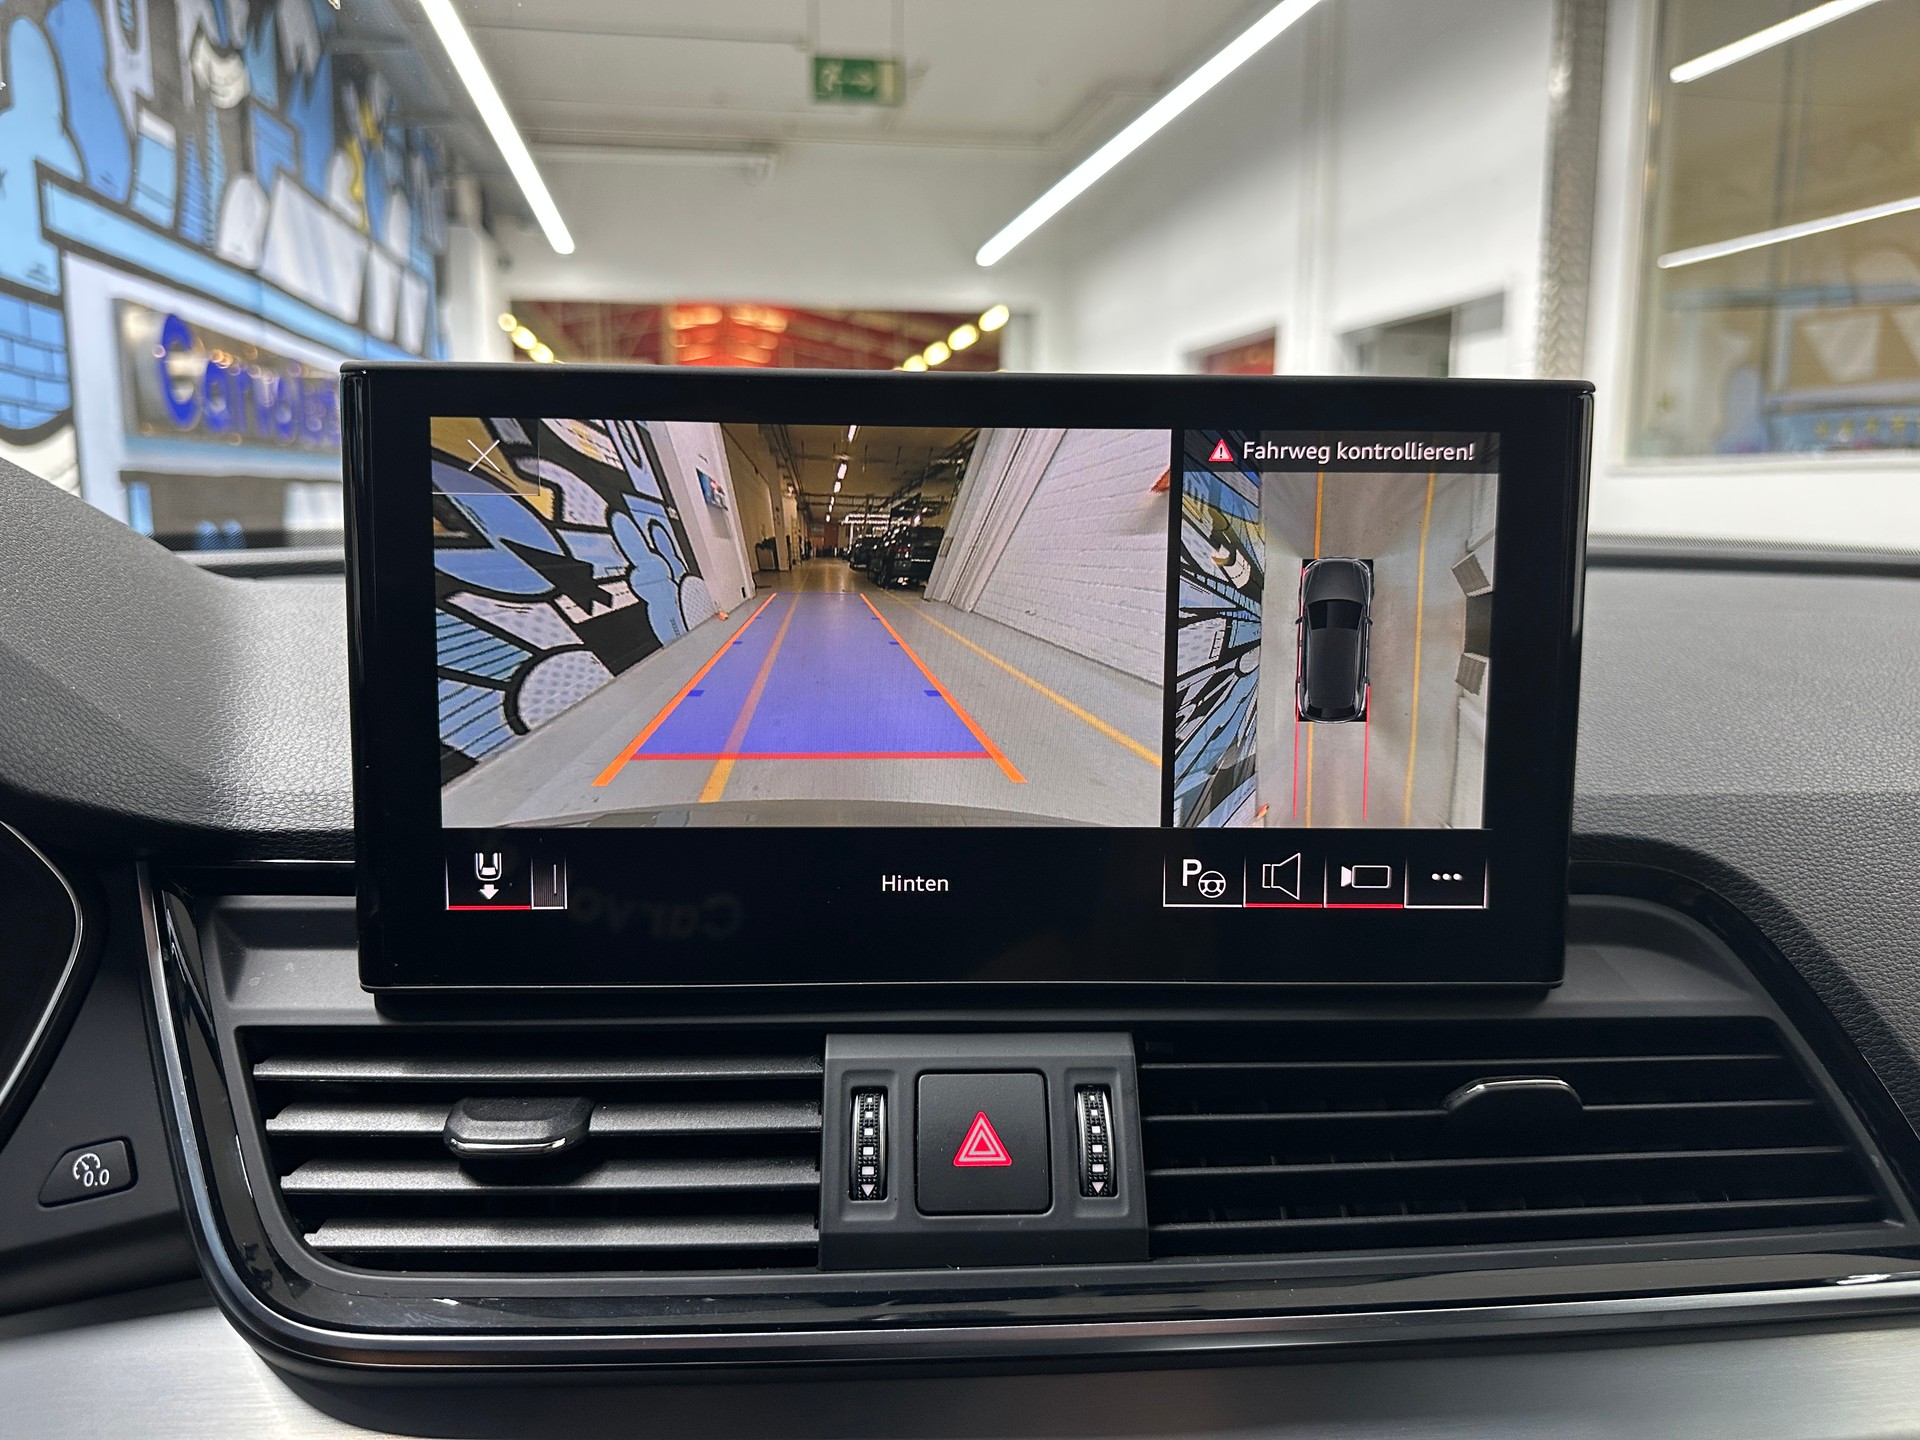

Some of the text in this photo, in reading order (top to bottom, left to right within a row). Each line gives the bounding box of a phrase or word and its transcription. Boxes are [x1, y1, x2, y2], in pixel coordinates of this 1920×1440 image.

[1243, 440, 1476, 465] Fahrweg kontrollieren!
[881, 874, 949, 892] Hinten
[1182, 858, 1203, 887] P
[83, 1168, 110, 1187] 0.0
